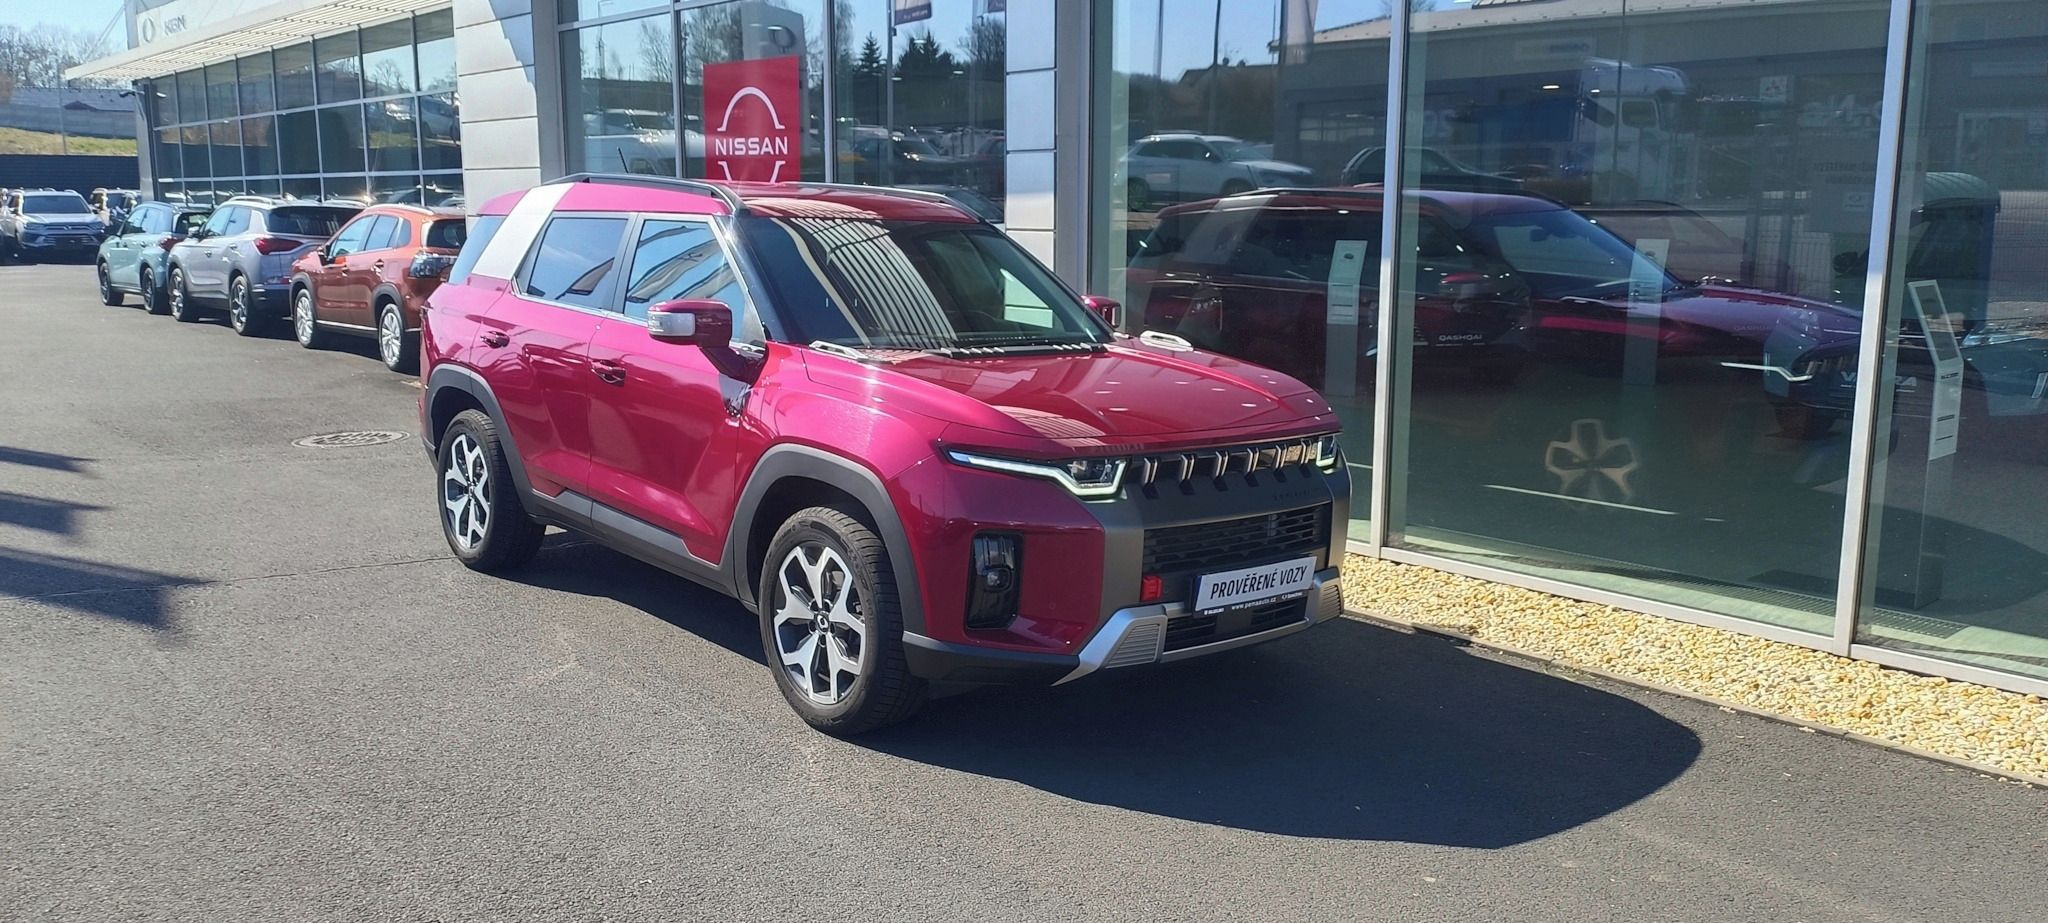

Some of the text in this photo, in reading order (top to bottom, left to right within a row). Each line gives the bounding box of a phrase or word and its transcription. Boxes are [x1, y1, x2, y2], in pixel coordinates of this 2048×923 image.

[715, 136, 788, 156] NISSAN
[1210, 565, 1308, 600] PROVĚŘENÉ VOZY
